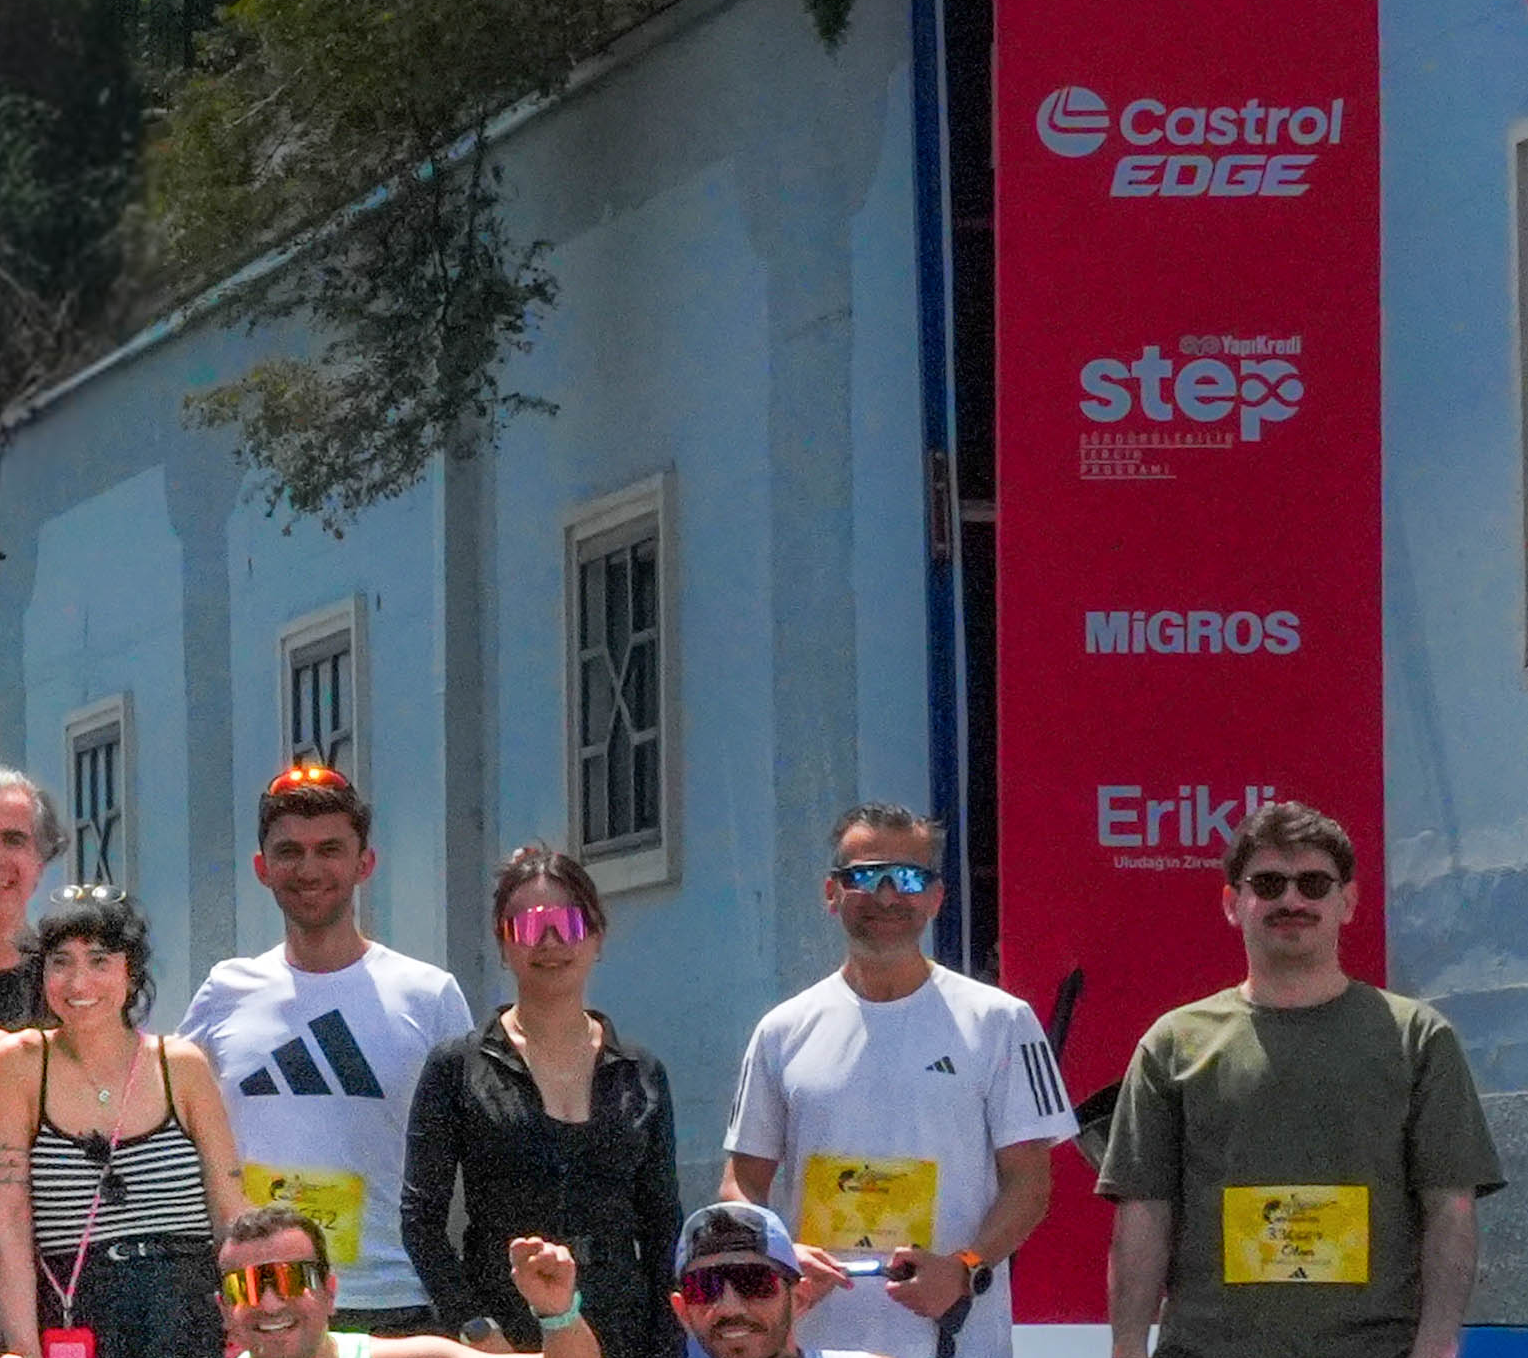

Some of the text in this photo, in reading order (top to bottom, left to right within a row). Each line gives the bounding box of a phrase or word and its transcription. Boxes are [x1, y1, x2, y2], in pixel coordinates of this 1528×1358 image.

[1119, 98, 1345, 146] Castrol
[1110, 154, 1320, 197] EDGE
[1079, 345, 1305, 441] step
[1097, 784, 1276, 847] Erik
